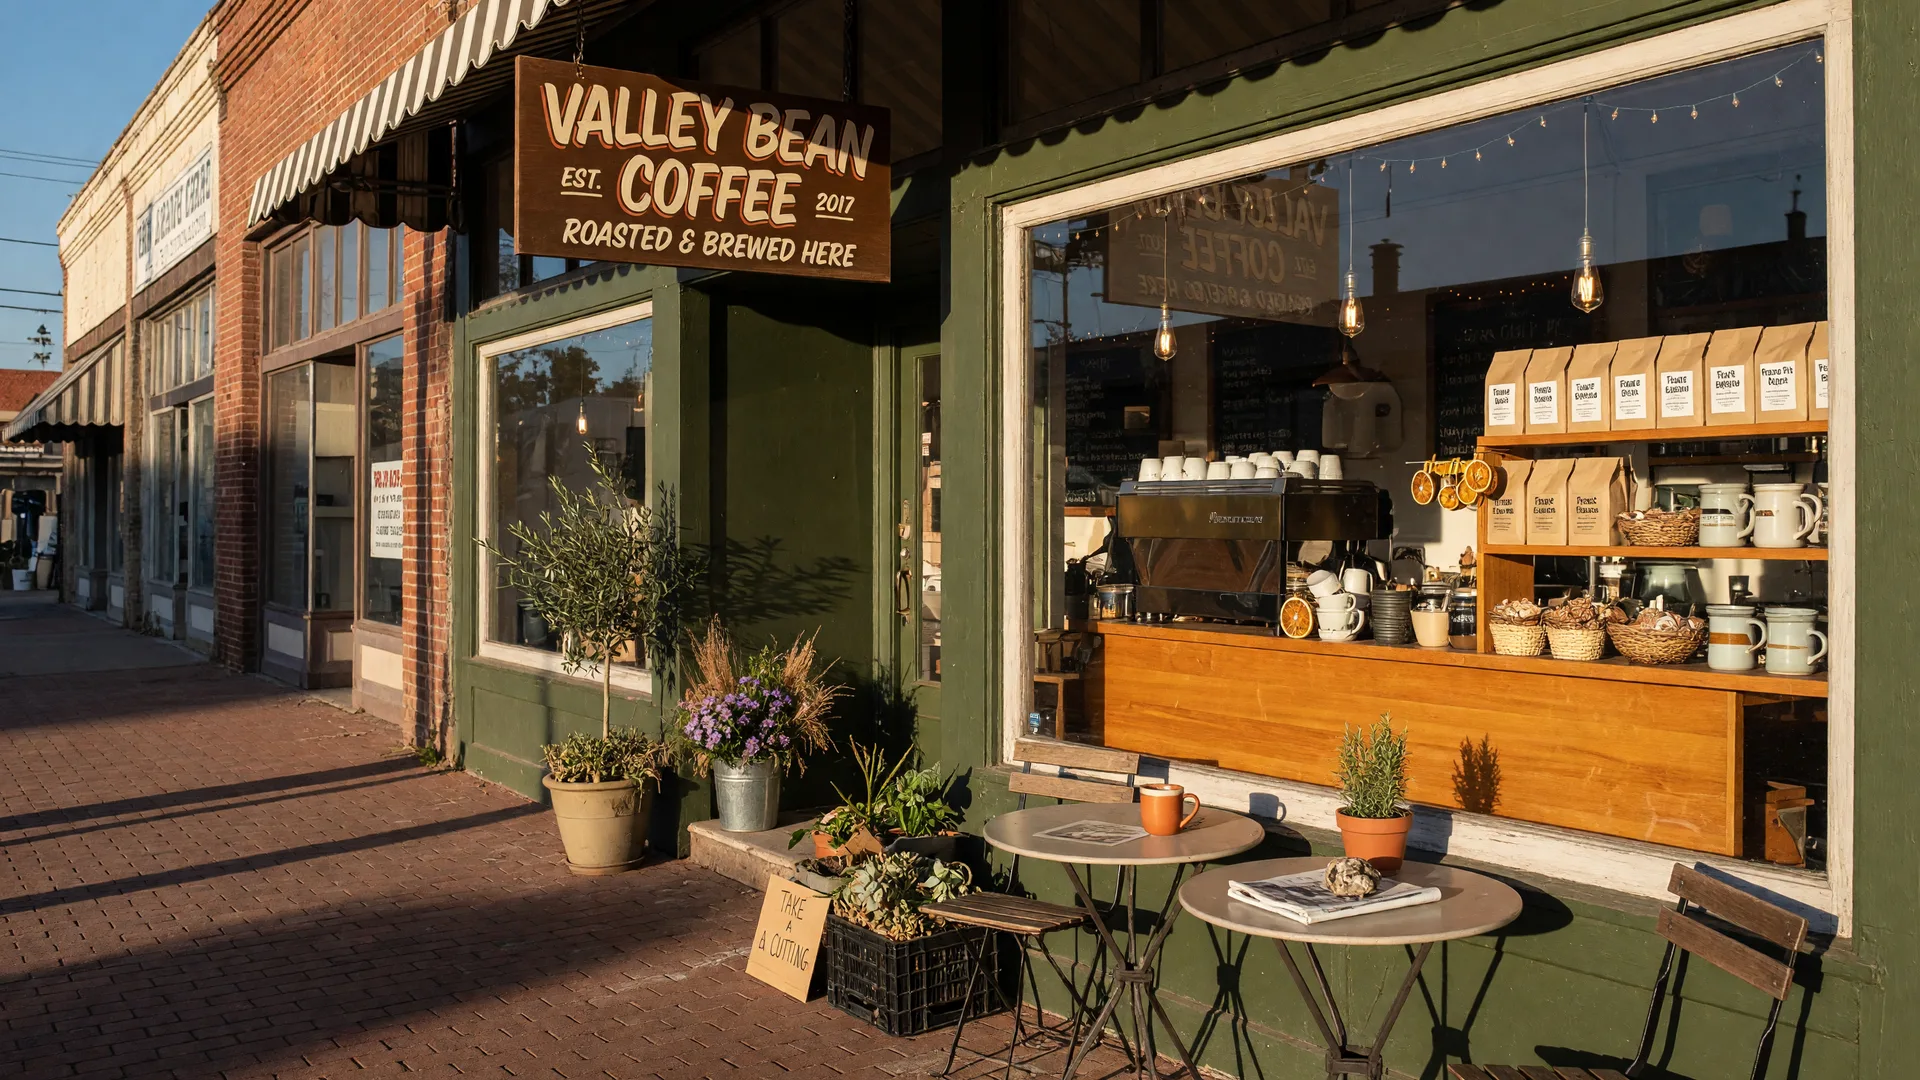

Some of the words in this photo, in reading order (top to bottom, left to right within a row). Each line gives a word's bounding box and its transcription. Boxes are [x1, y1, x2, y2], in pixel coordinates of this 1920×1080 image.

[540, 82, 734, 155] VALLEY
[743, 102, 875, 181] BEAN
[561, 166, 602, 190] EST.
[616, 154, 803, 229] COFFEE
[815, 192, 855, 214] 2017
[562, 218, 673, 253] ROASTED
[678, 228, 695, 255] &
[703, 231, 796, 262] BREWED
[801, 240, 857, 267] HERE
[780, 889, 807, 921] TAKE
[785, 920, 792, 933] A
[769, 933, 810, 971] CUTTING
